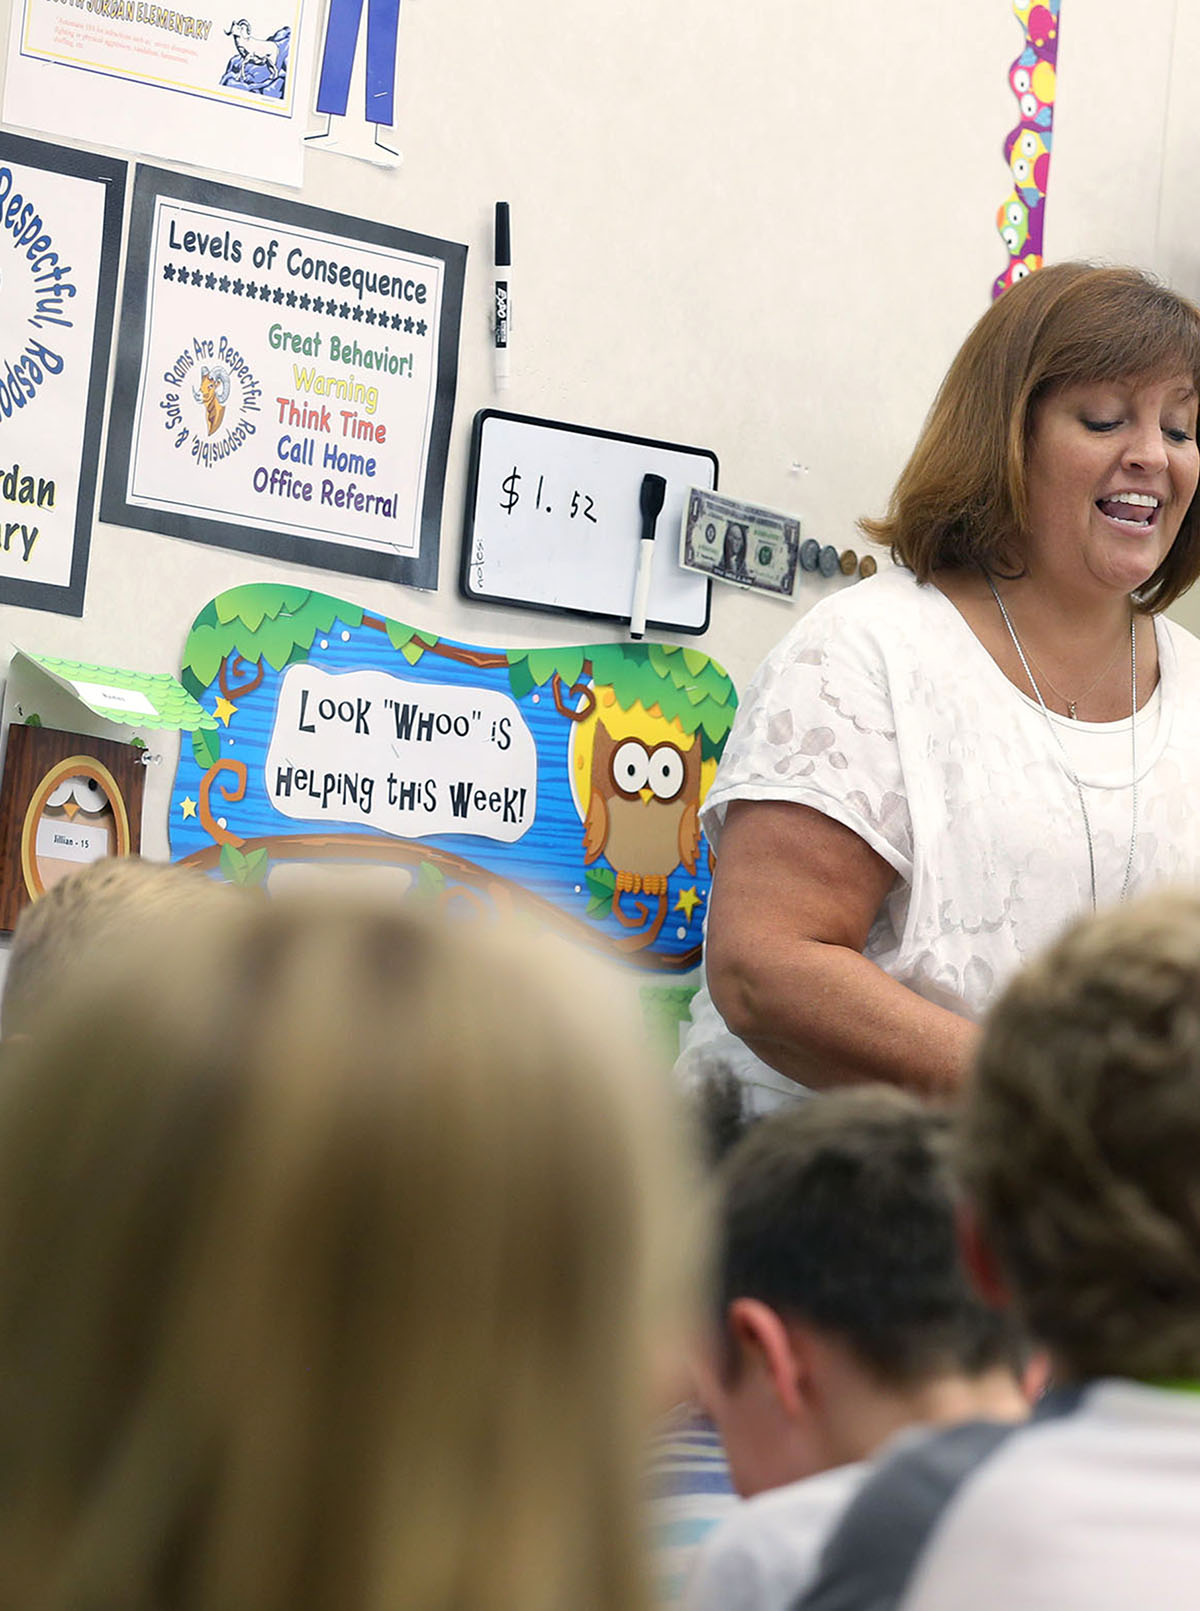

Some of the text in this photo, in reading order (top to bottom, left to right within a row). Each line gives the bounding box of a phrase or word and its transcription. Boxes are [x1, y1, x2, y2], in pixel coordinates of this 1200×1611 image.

[136, 3, 213, 40] ELEMENTARY
[169, 220, 427, 304] Levels of Consequence
[496, 287, 507, 319] EXPO
[164, 349, 194, 387] Rams
[193, 337, 214, 361] Are
[268, 323, 414, 378] Great Behavior!
[293, 364, 378, 413] Warning
[160, 393, 183, 430] Safe
[276, 397, 387, 443] Think Time
[277, 435, 377, 477] Call Home
[0, 464, 55, 507] dan
[253, 467, 398, 519] Office Referral
[0, 522, 39, 562] ry
[53, 834, 74, 846] Jillian
[81, 840, 90, 849] 15
